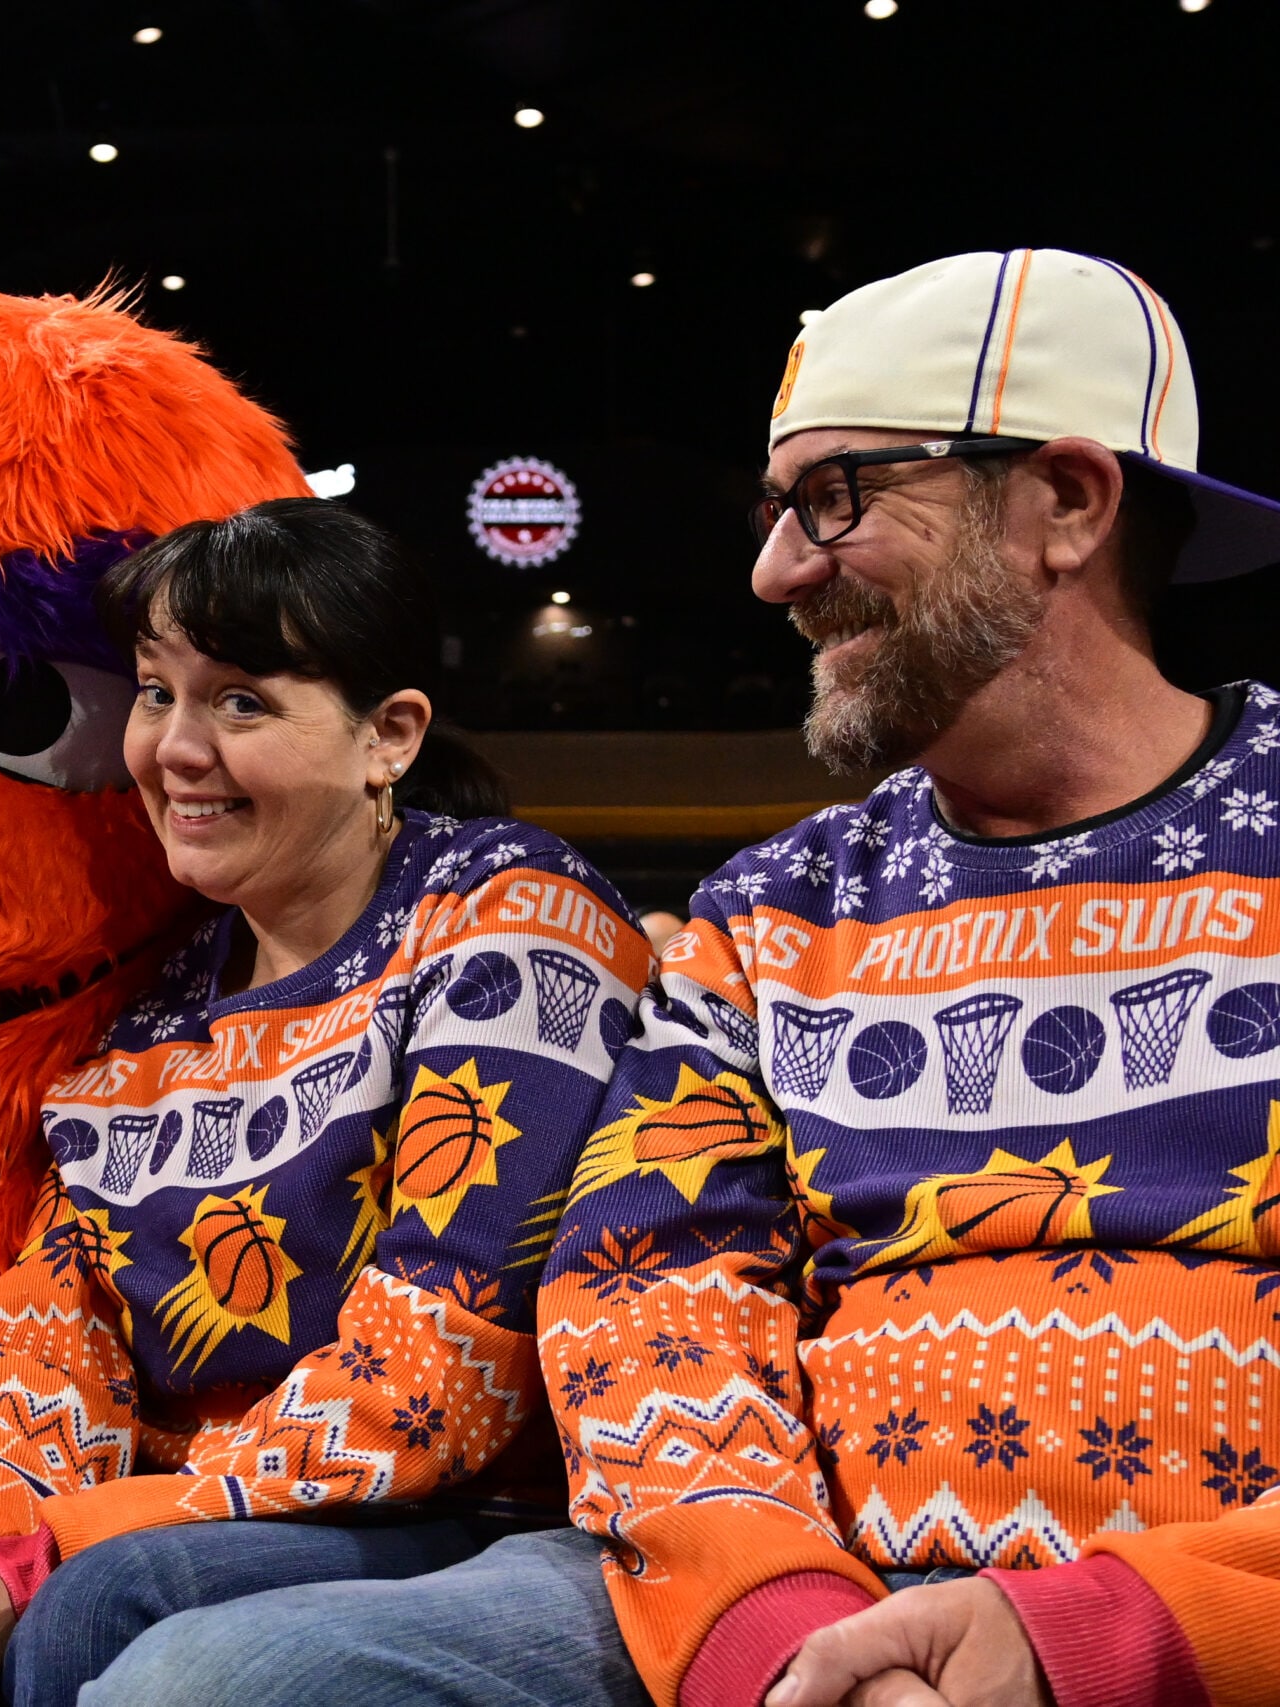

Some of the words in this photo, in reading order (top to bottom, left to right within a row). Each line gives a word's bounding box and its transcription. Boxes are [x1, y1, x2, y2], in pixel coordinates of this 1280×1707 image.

[498, 879, 617, 961] SUNS
[848, 901, 1063, 982] PHOENIX
[1070, 886, 1263, 958] SUNS
[278, 980, 382, 1065] SUNS
